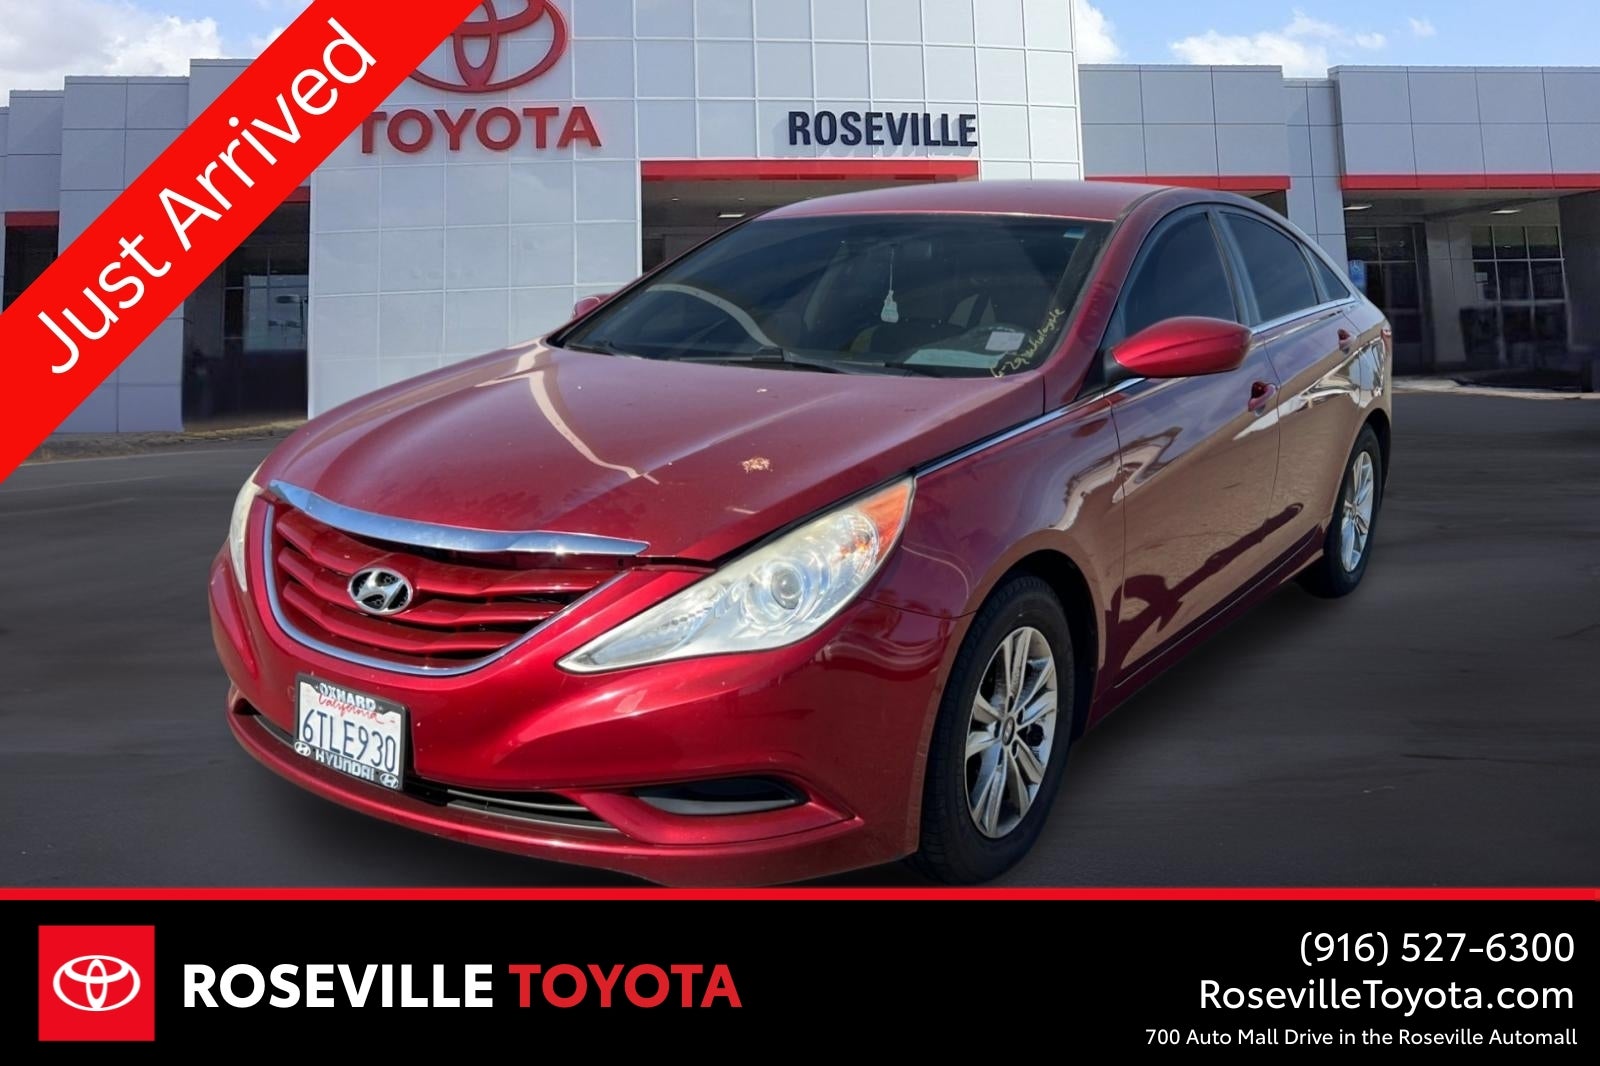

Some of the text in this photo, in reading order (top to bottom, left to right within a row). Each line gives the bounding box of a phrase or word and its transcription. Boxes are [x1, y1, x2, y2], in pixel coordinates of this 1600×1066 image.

[361, 106, 602, 154] TOYOTA
[788, 110, 978, 147] ROSEVILLE
[319, 682, 376, 711] OXNARD
[302, 708, 396, 773] 6TLE930
[315, 750, 375, 781] HYUNDAI
